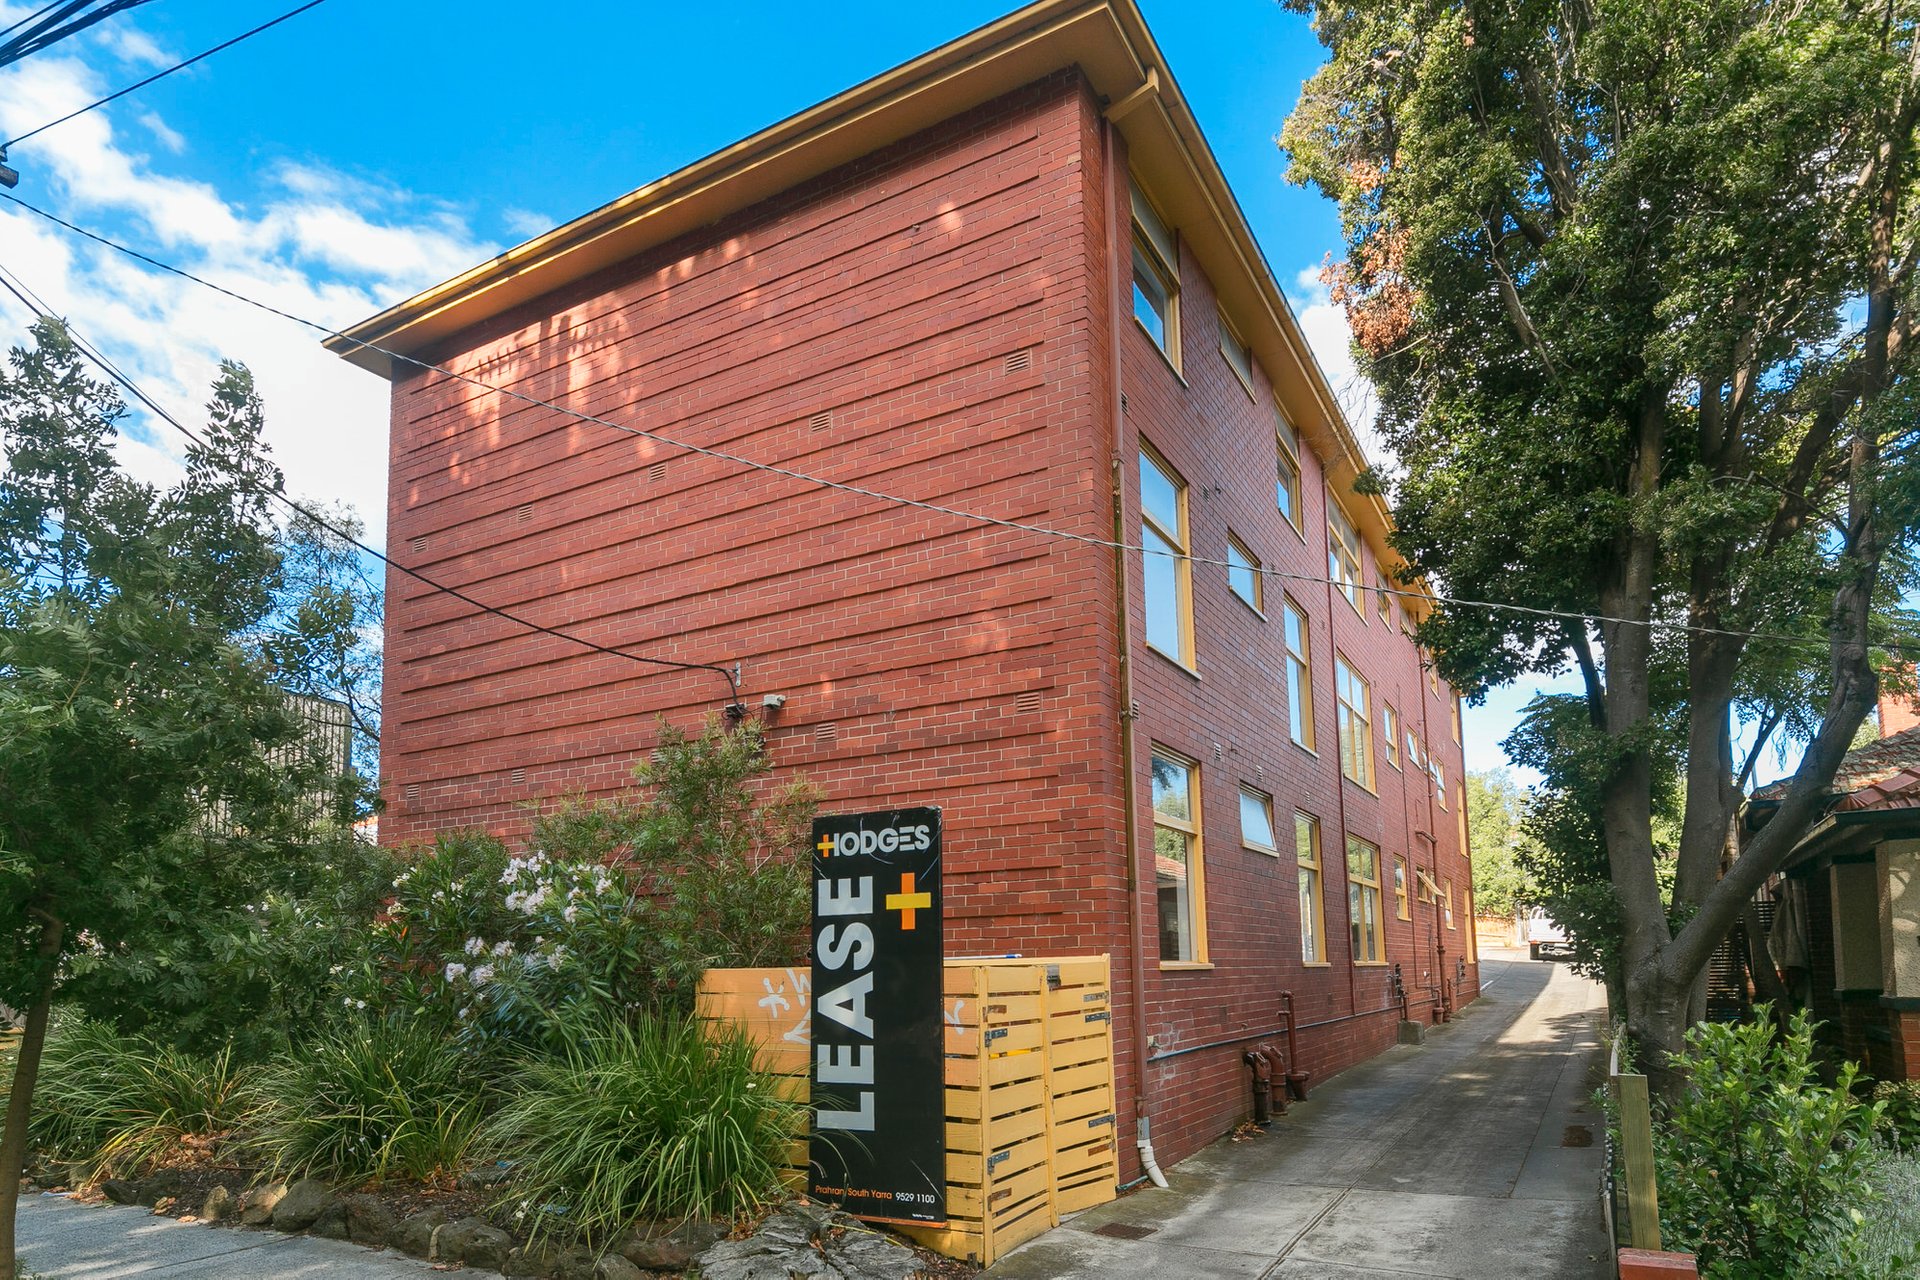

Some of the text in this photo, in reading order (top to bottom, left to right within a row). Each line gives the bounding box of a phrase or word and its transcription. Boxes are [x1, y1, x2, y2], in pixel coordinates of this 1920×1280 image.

[817, 824, 931, 858] HODGES
[816, 875, 875, 1131] LEASE
[815, 1184, 936, 1204] Prahran South Yarra 9529 1100
